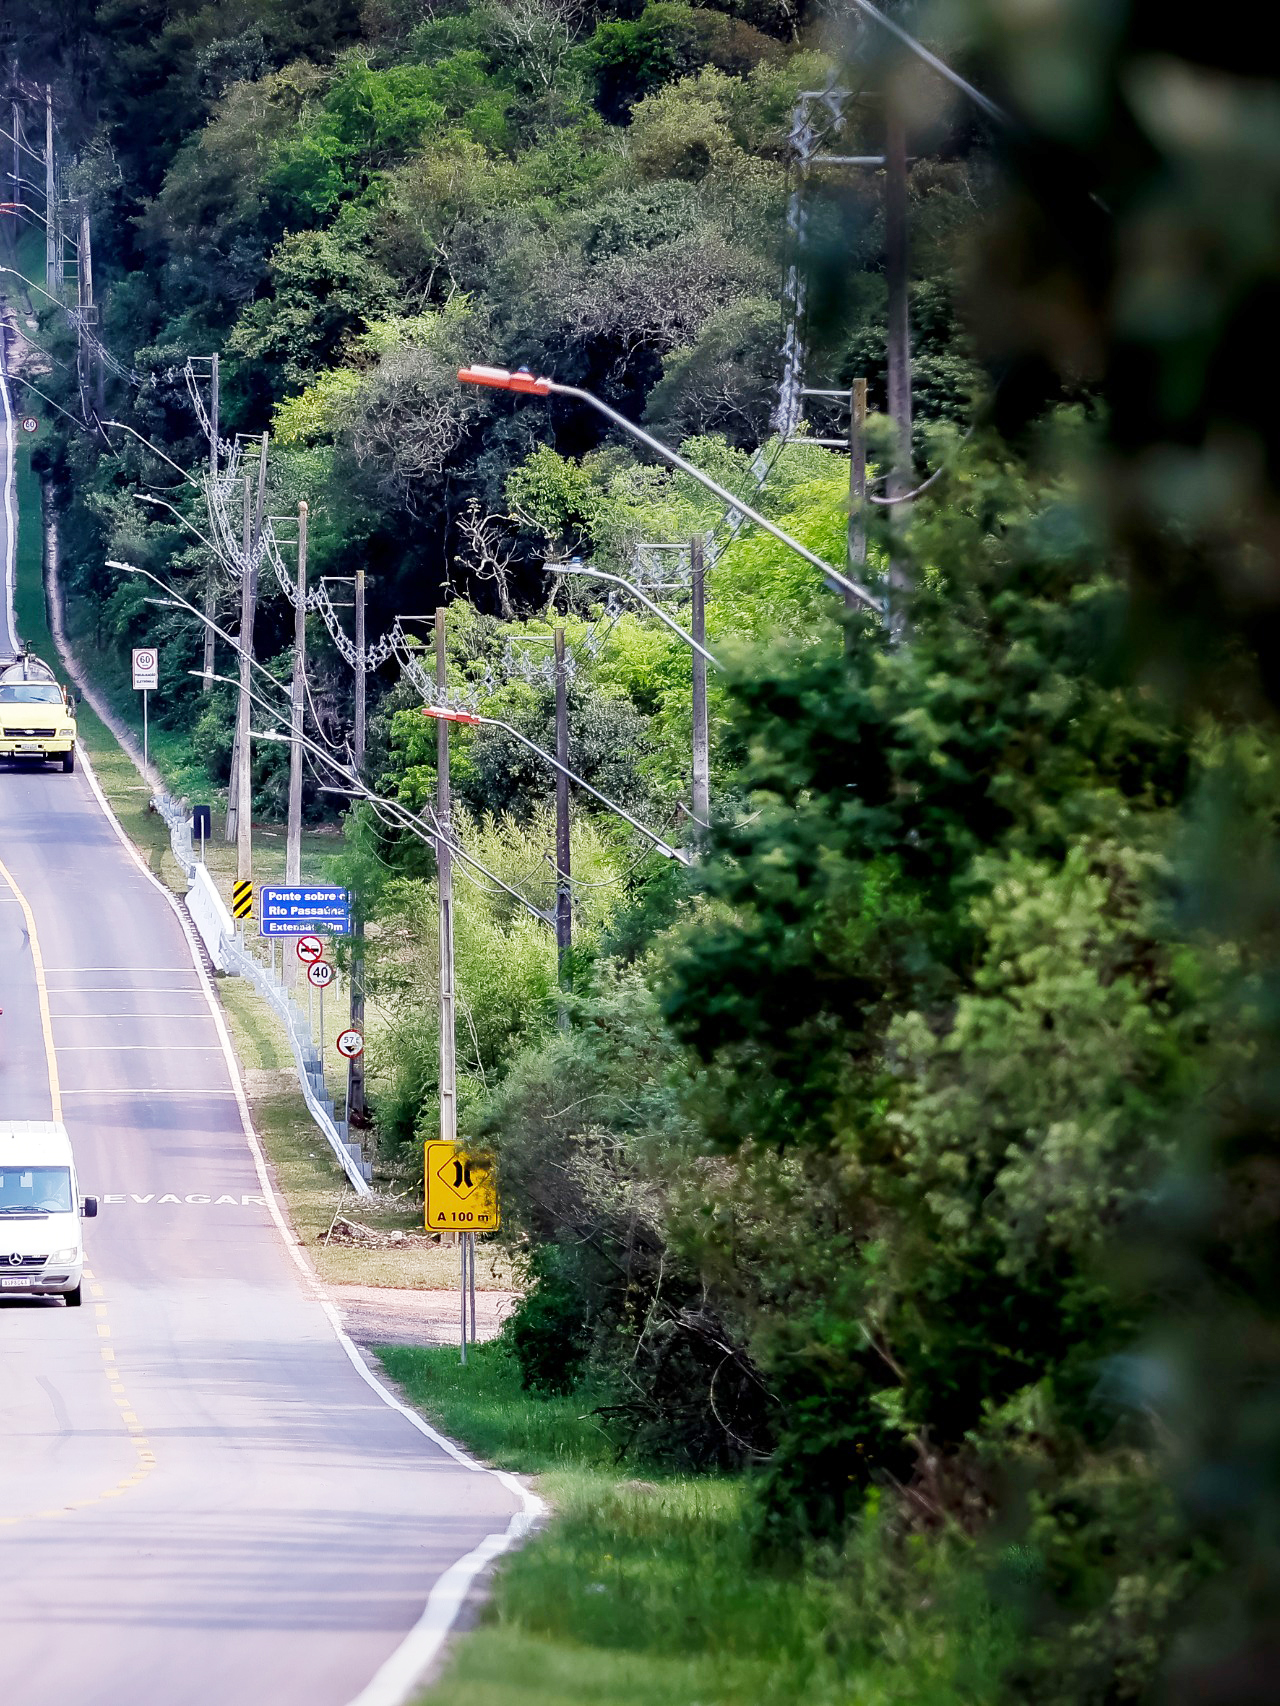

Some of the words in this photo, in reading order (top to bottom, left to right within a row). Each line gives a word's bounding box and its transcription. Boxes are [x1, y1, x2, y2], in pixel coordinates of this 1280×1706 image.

[140, 655, 151, 664] 60
[268, 891, 302, 901] Ponte
[304, 891, 336, 901] sobre
[268, 906, 288, 916] Rio
[312, 966, 328, 978] 40
[437, 1211, 447, 1222] A
[451, 1211, 474, 1222] 100
[477, 1214, 489, 1222] m
